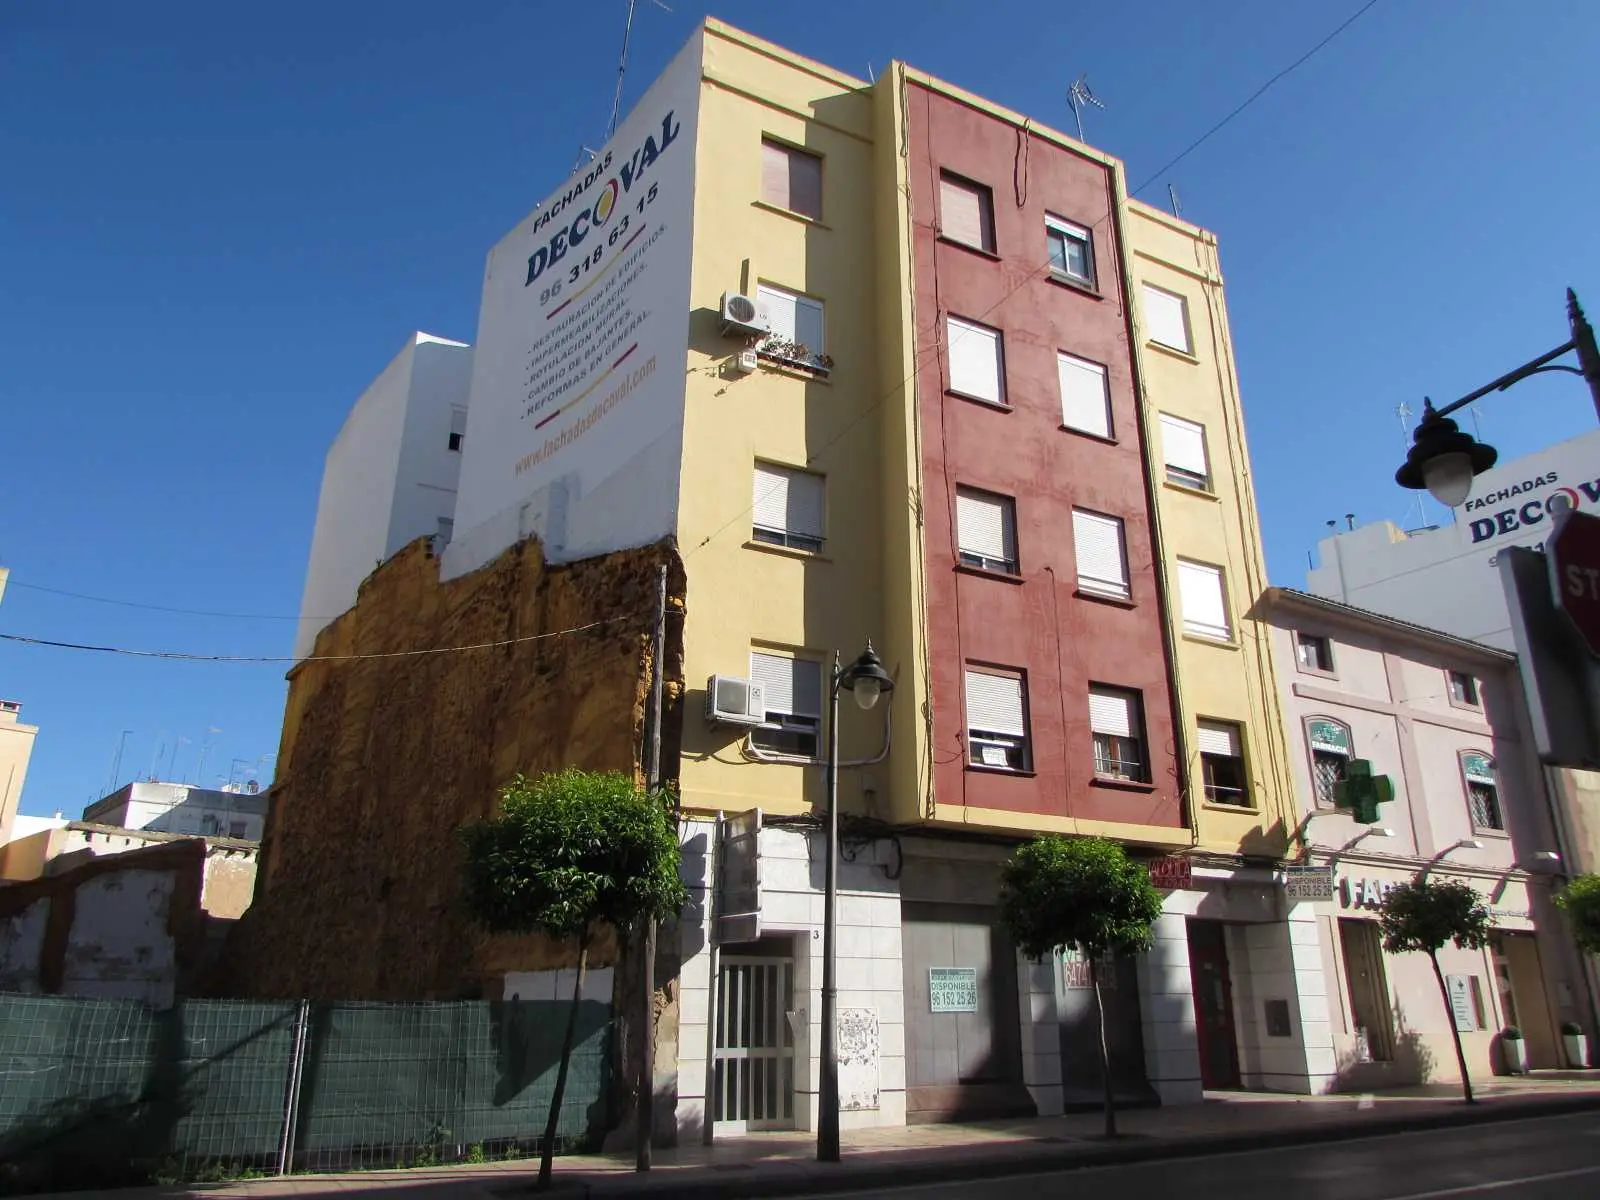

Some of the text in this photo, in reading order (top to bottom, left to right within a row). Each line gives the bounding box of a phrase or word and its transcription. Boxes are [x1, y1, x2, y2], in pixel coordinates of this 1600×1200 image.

[525, 110, 681, 288] DECOVAL
[533, 151, 613, 234] FACHADAS
[540, 181, 659, 307] 96 318 63 15
[527, 368, 587, 417] REFORMAS
[590, 353, 603, 372] EN
[528, 367, 566, 400] CAMBIO
[568, 357, 581, 372] DE
[1465, 471, 1558, 513] FACHADAS
[1469, 479, 1600, 544] DECOV
[1566, 564, 1600, 600] ST
[1287, 877, 1332, 885] DISPONIBLE
[813, 930, 820, 940] 3
[931, 982, 977, 991] DISPONIBLE
[931, 991, 977, 1006] 96 152 25 26
